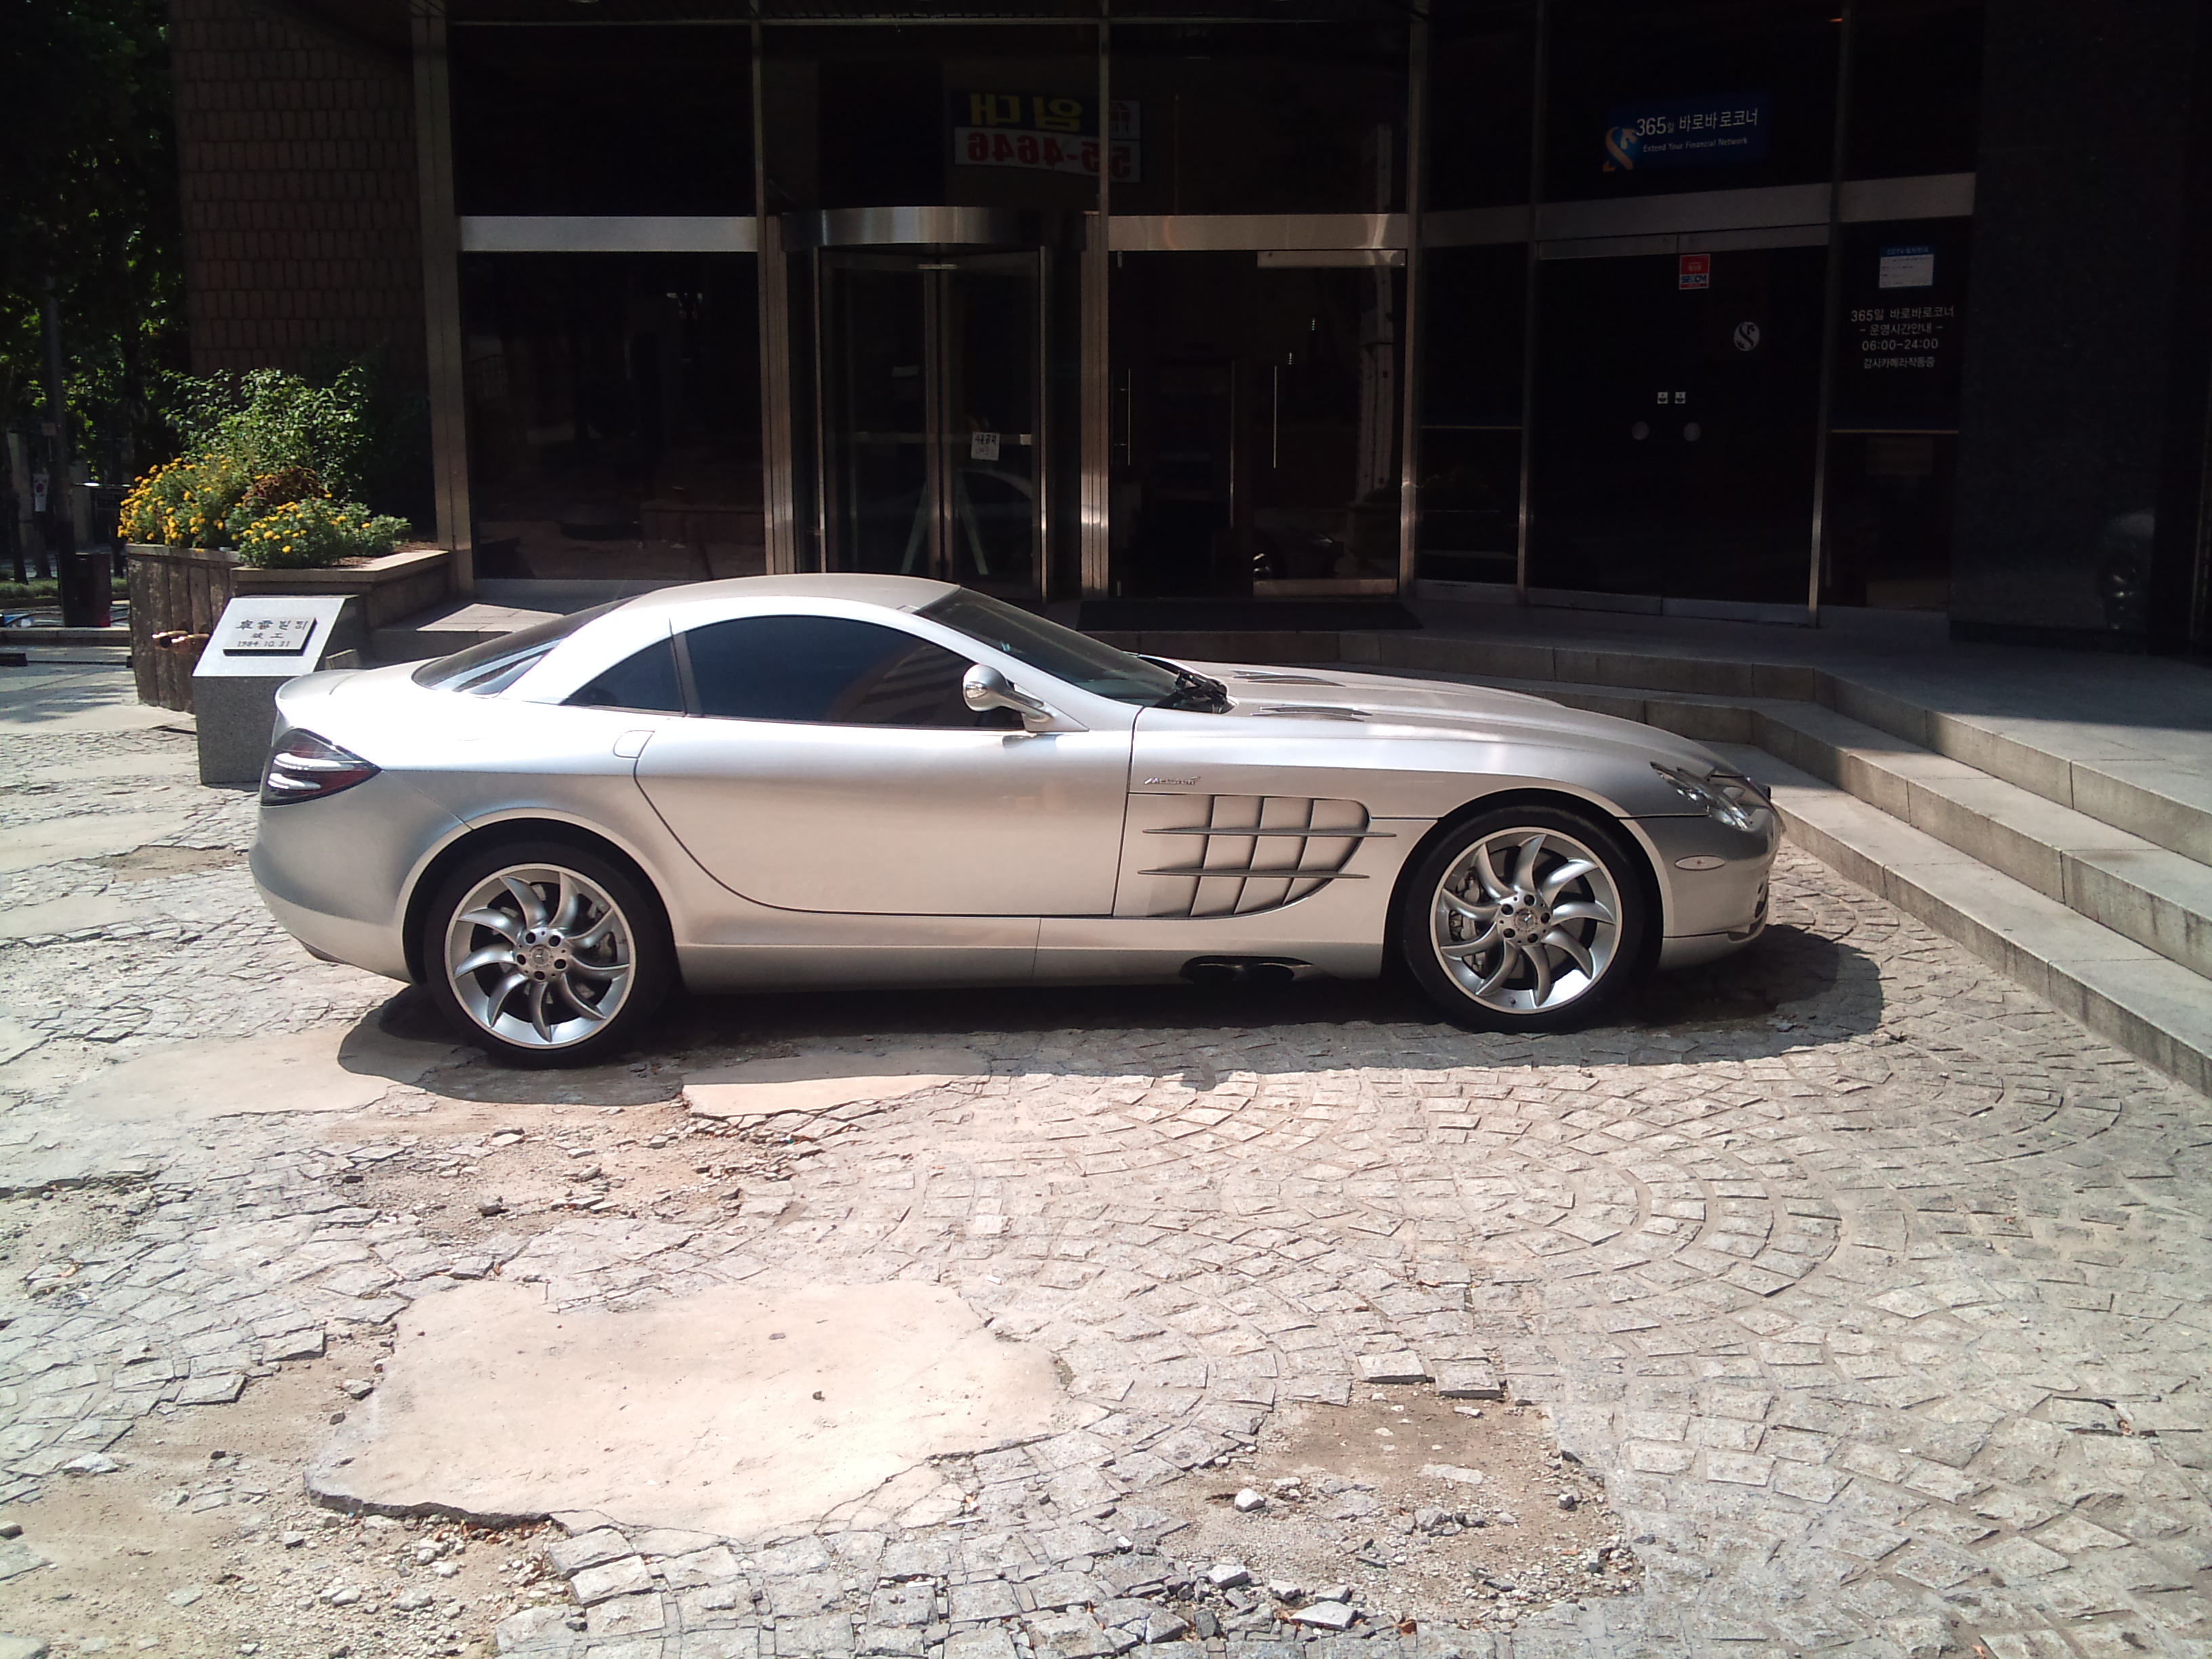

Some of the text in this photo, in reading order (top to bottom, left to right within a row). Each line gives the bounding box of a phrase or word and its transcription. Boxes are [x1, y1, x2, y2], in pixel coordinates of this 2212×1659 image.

[1679, 108, 1758, 131] 바로바로코너
[1643, 136, 1748, 152] Extend Your Financial Network
[1851, 306, 1954, 322] 365일 바로바로코너
[1870, 323, 1932, 335] 운영시간안내
[1862, 338, 1938, 351] 06:00-24:00
